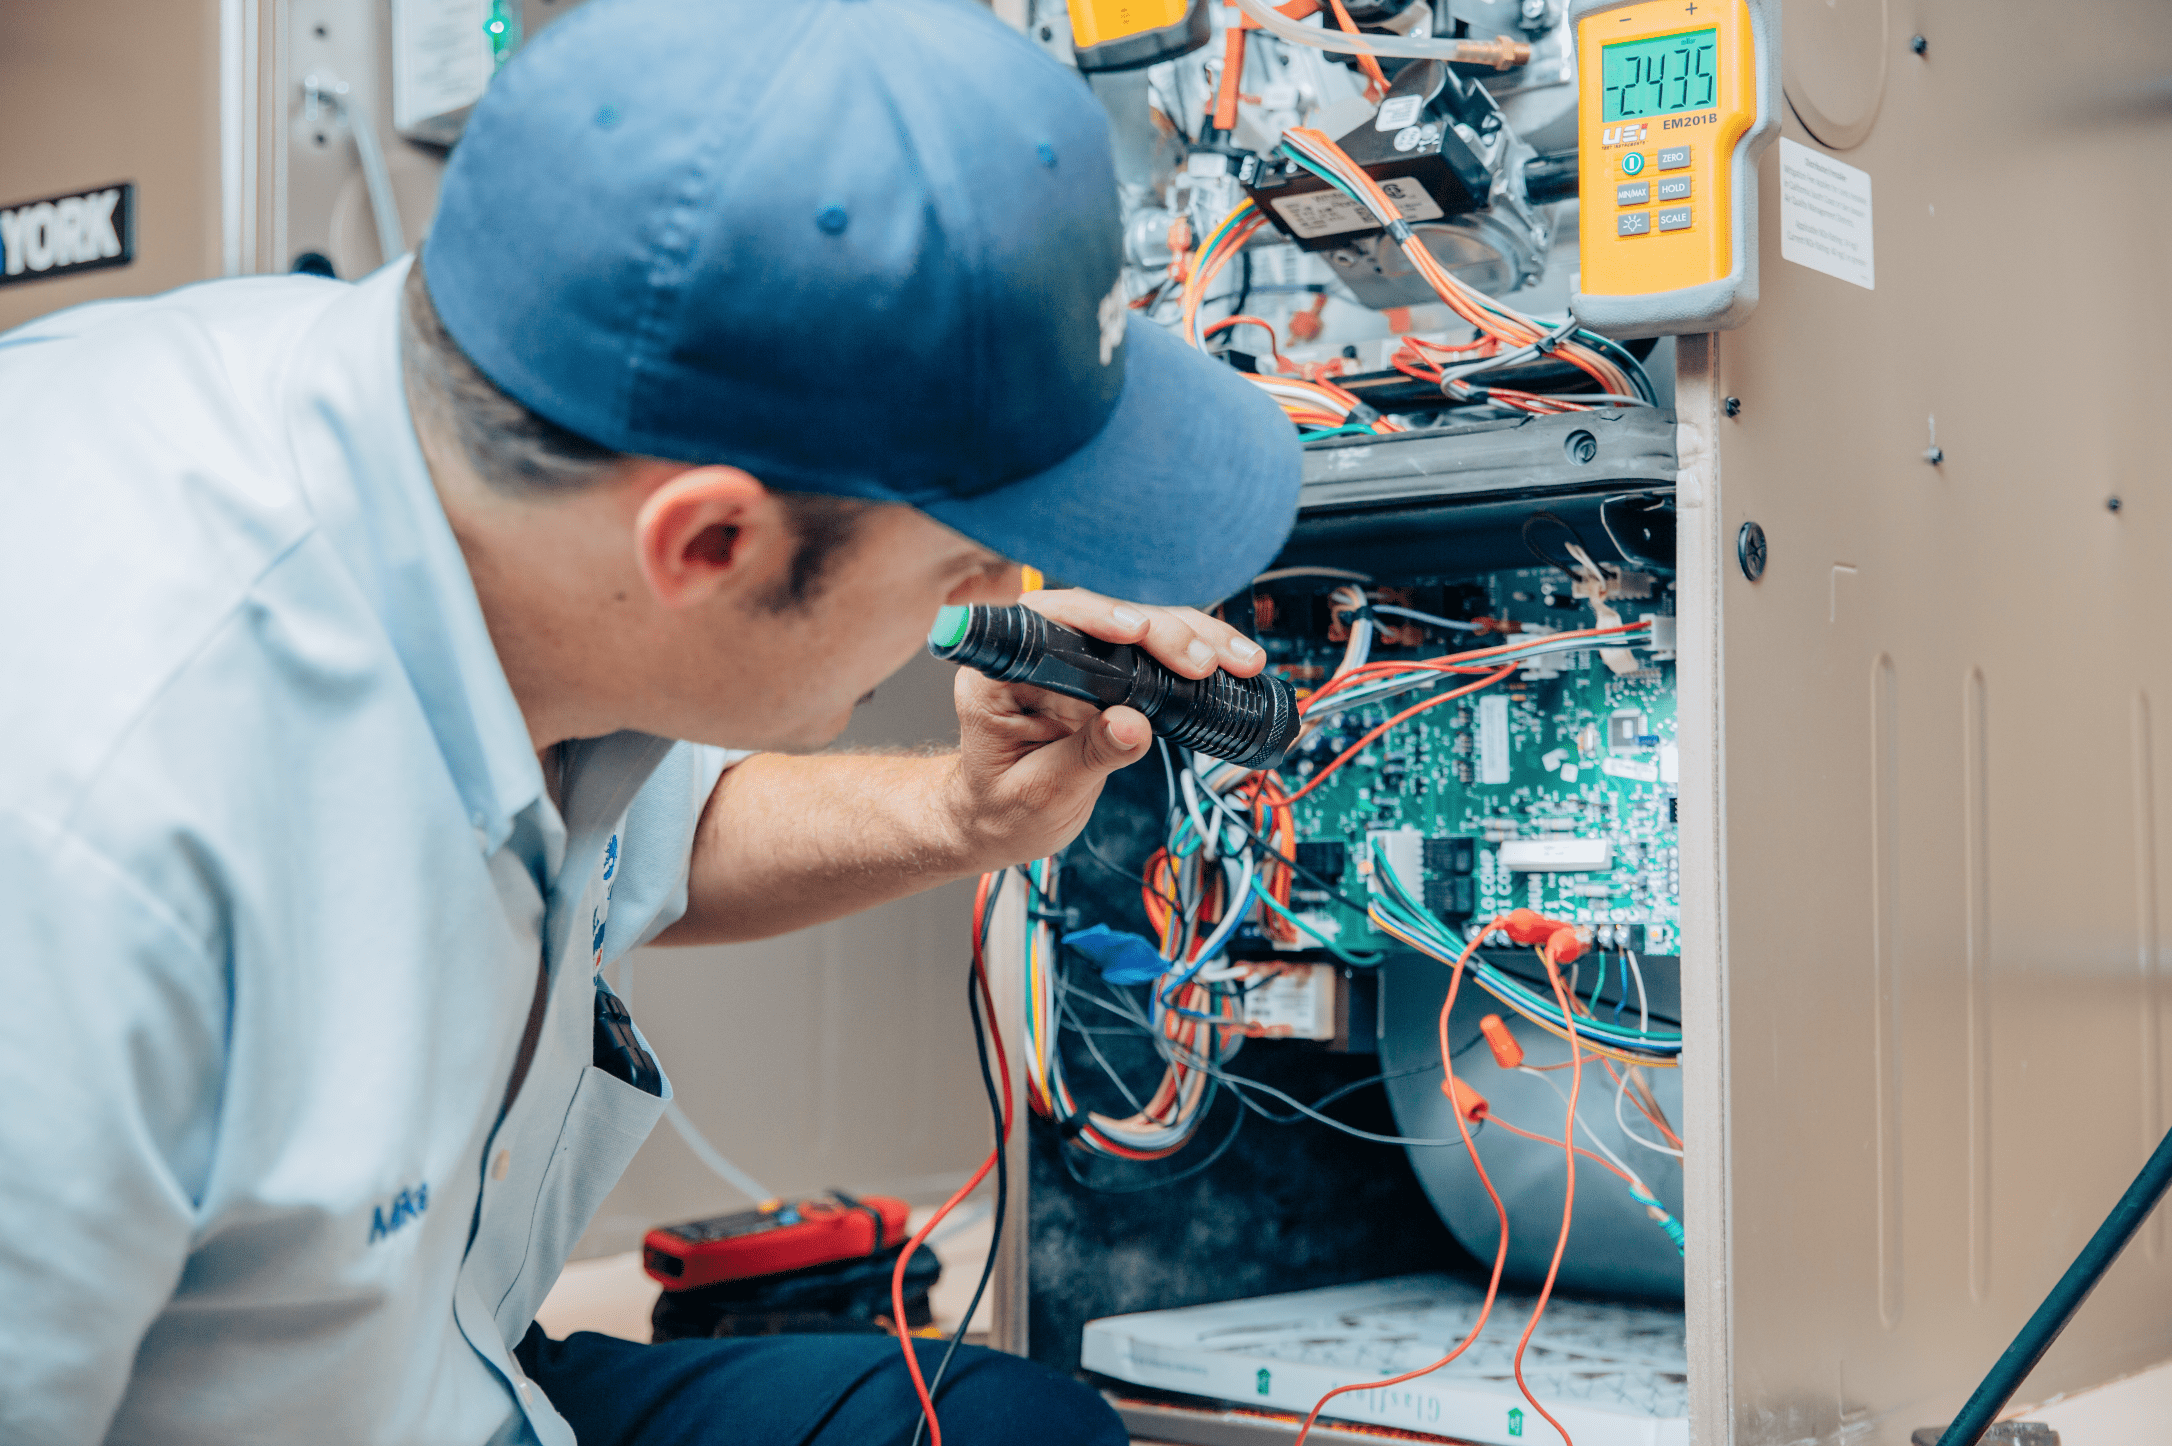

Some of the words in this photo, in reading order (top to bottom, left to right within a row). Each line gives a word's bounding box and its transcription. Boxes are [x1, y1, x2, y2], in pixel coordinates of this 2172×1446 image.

[1663, 113, 1718, 130] EM201B
[1662, 152, 1684, 163] ZERO
[1617, 188, 1647, 199] MIN/MAX
[1661, 183, 1685, 194] HOLD
[1660, 213, 1687, 224] SCALE
[0, 188, 122, 275] YORK
